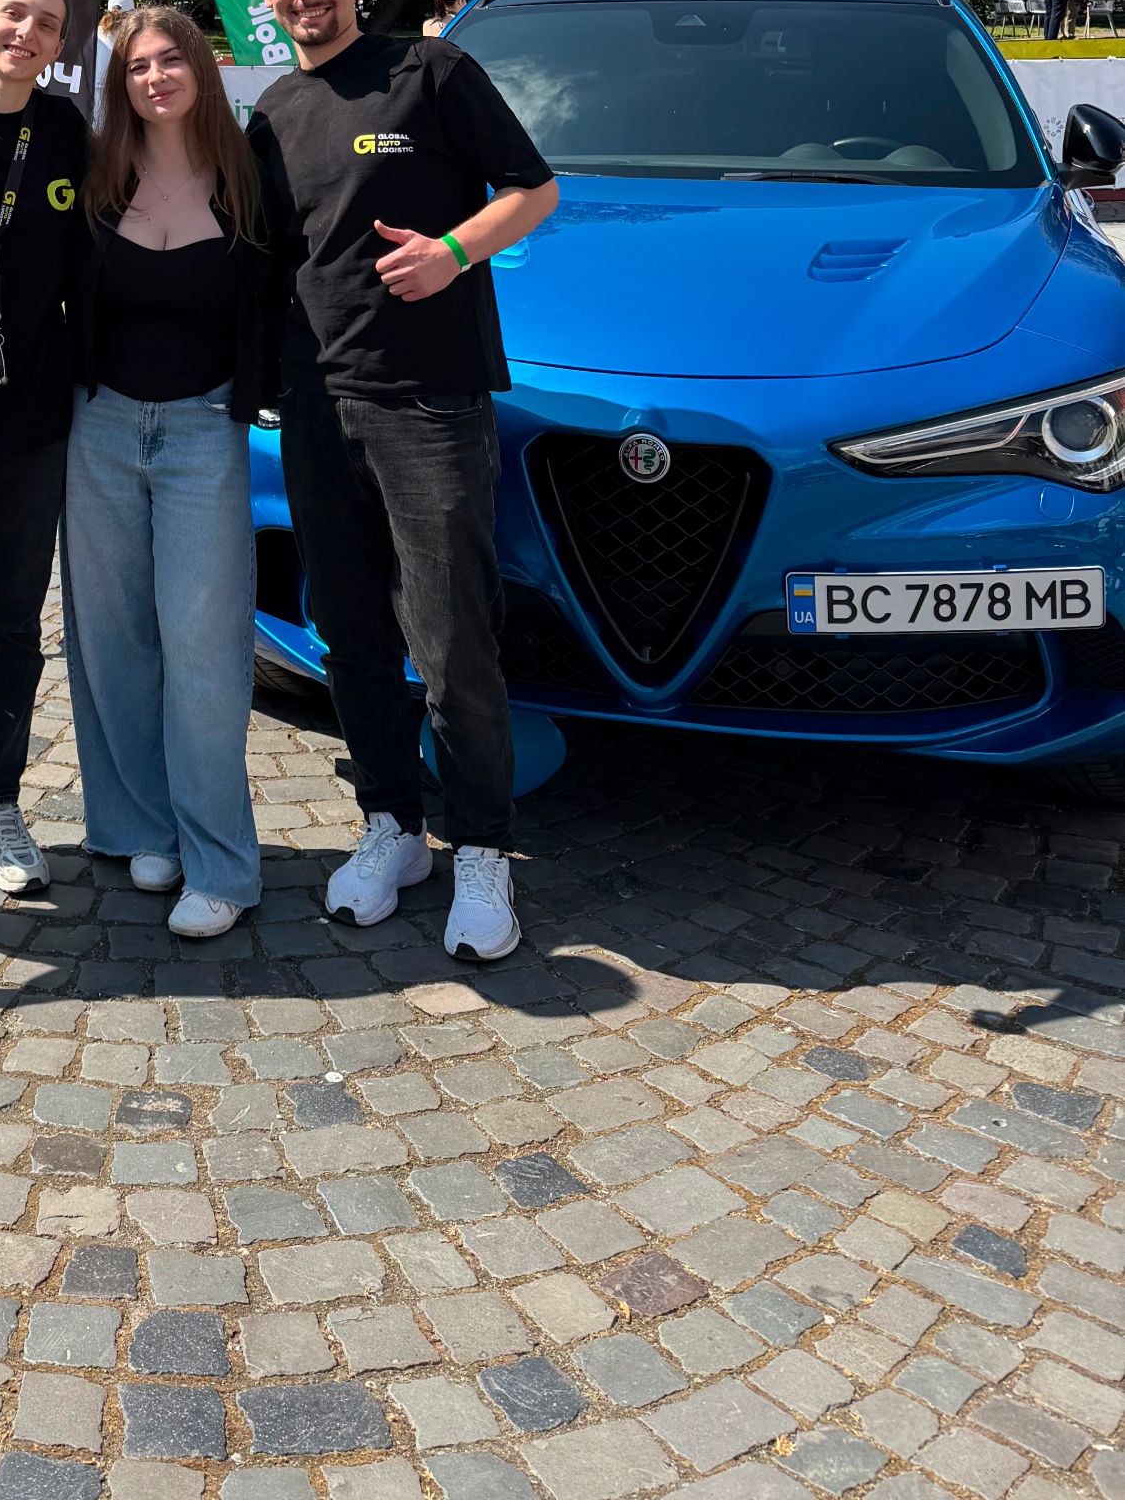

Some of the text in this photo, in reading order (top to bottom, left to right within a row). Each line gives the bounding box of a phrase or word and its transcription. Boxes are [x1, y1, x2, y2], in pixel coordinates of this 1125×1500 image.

[826, 579, 1092, 625] BC 7878 MB
[794, 611, 815, 624] UA
